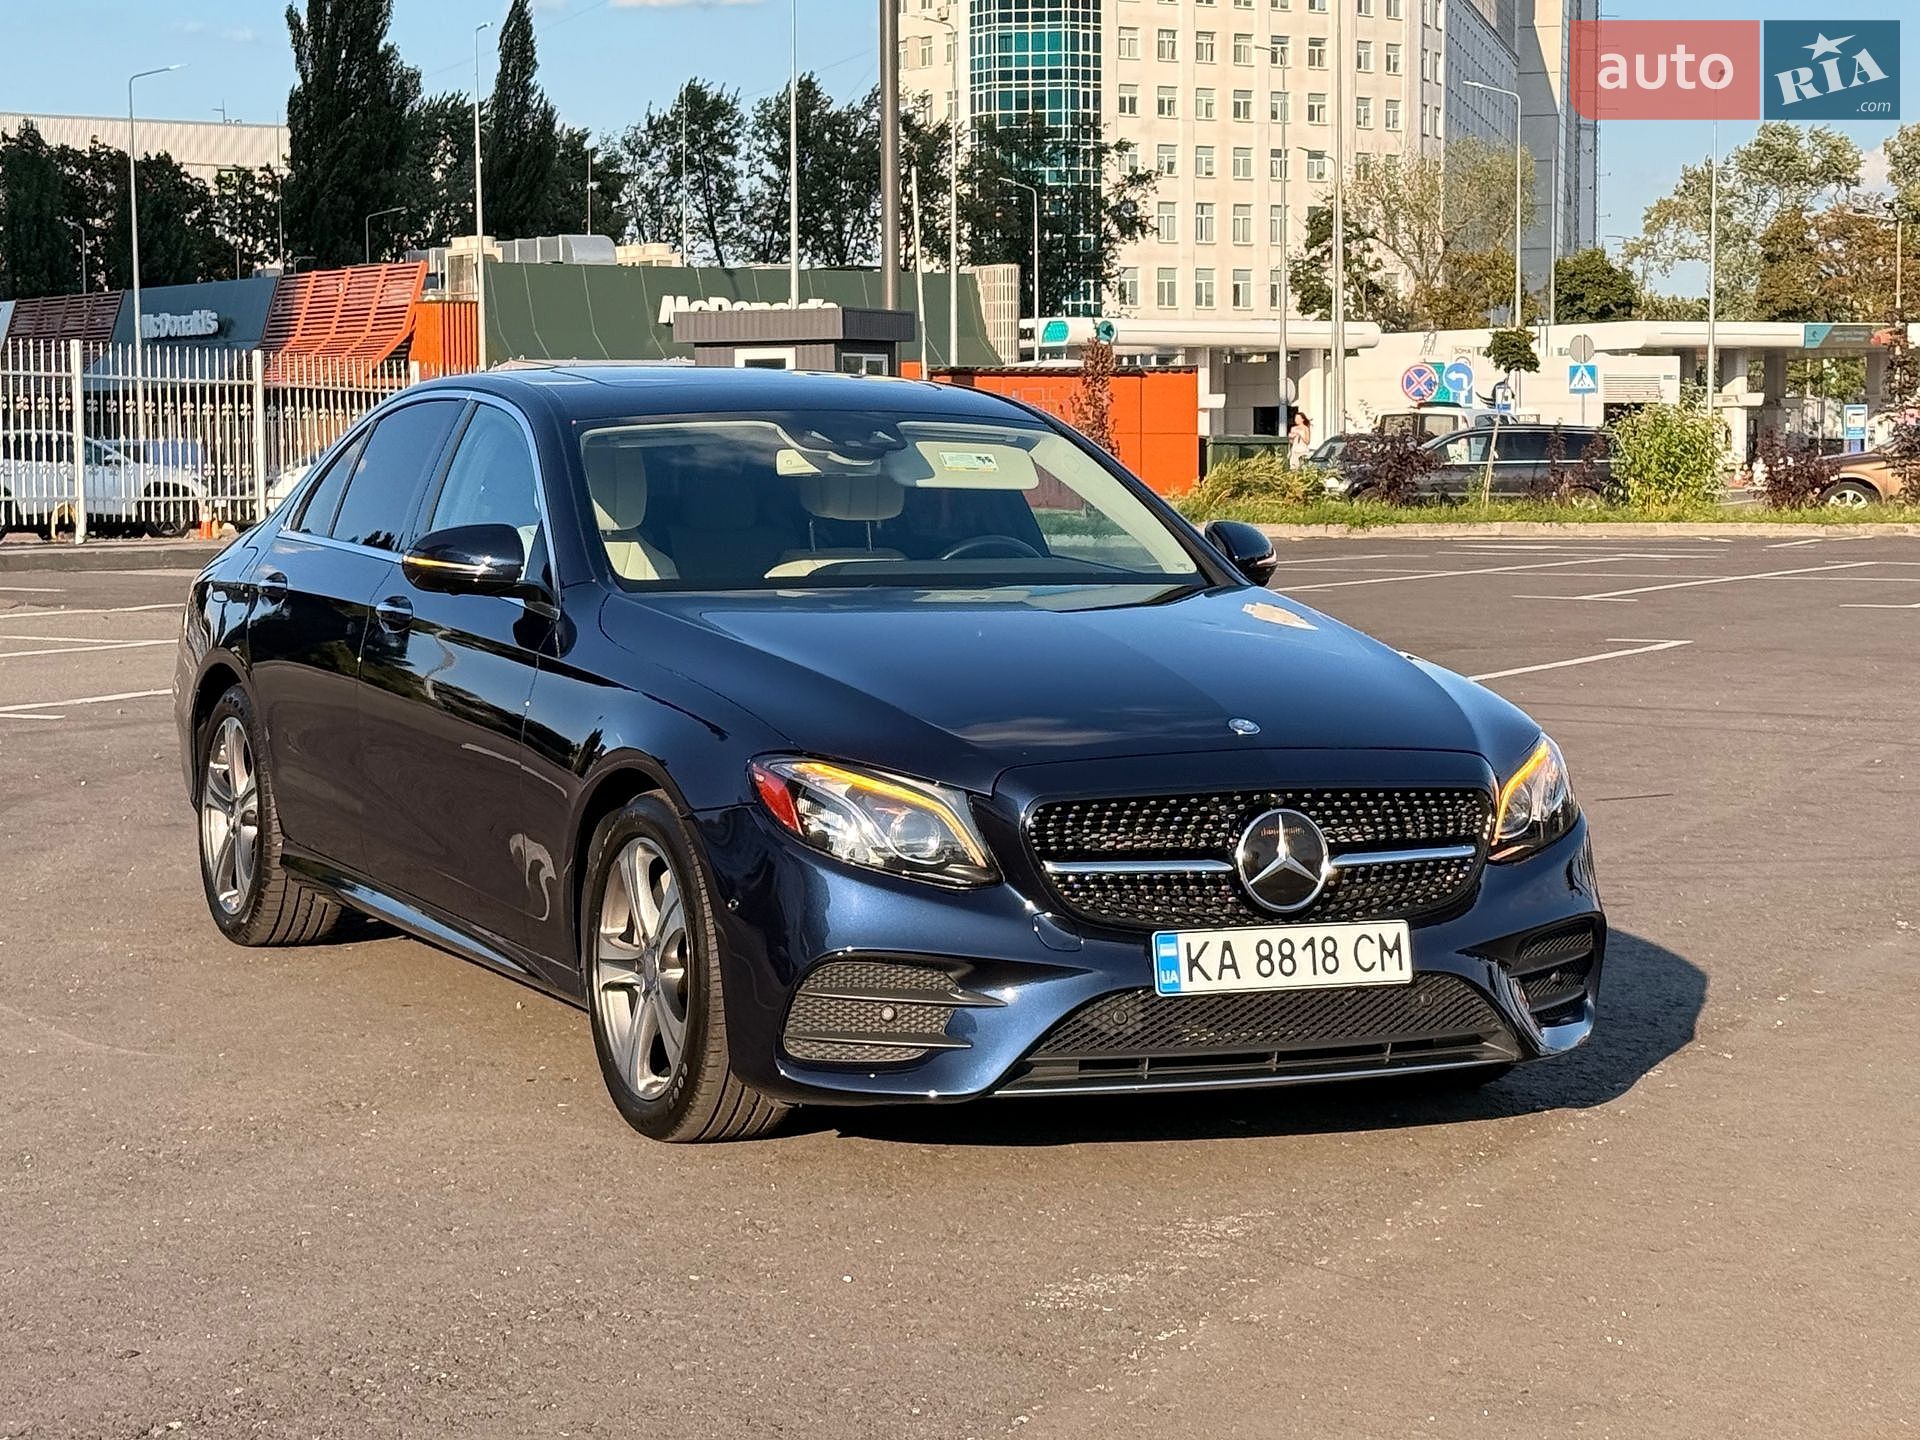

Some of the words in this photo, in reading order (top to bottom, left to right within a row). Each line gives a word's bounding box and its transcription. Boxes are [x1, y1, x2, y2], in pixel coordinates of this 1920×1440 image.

[141, 309, 219, 339] McDonald's
[1185, 940, 1241, 983] KA
[1255, 935, 1340, 978] 8818
[1353, 931, 1404, 973] CM
[1160, 969, 1179, 984] UA
